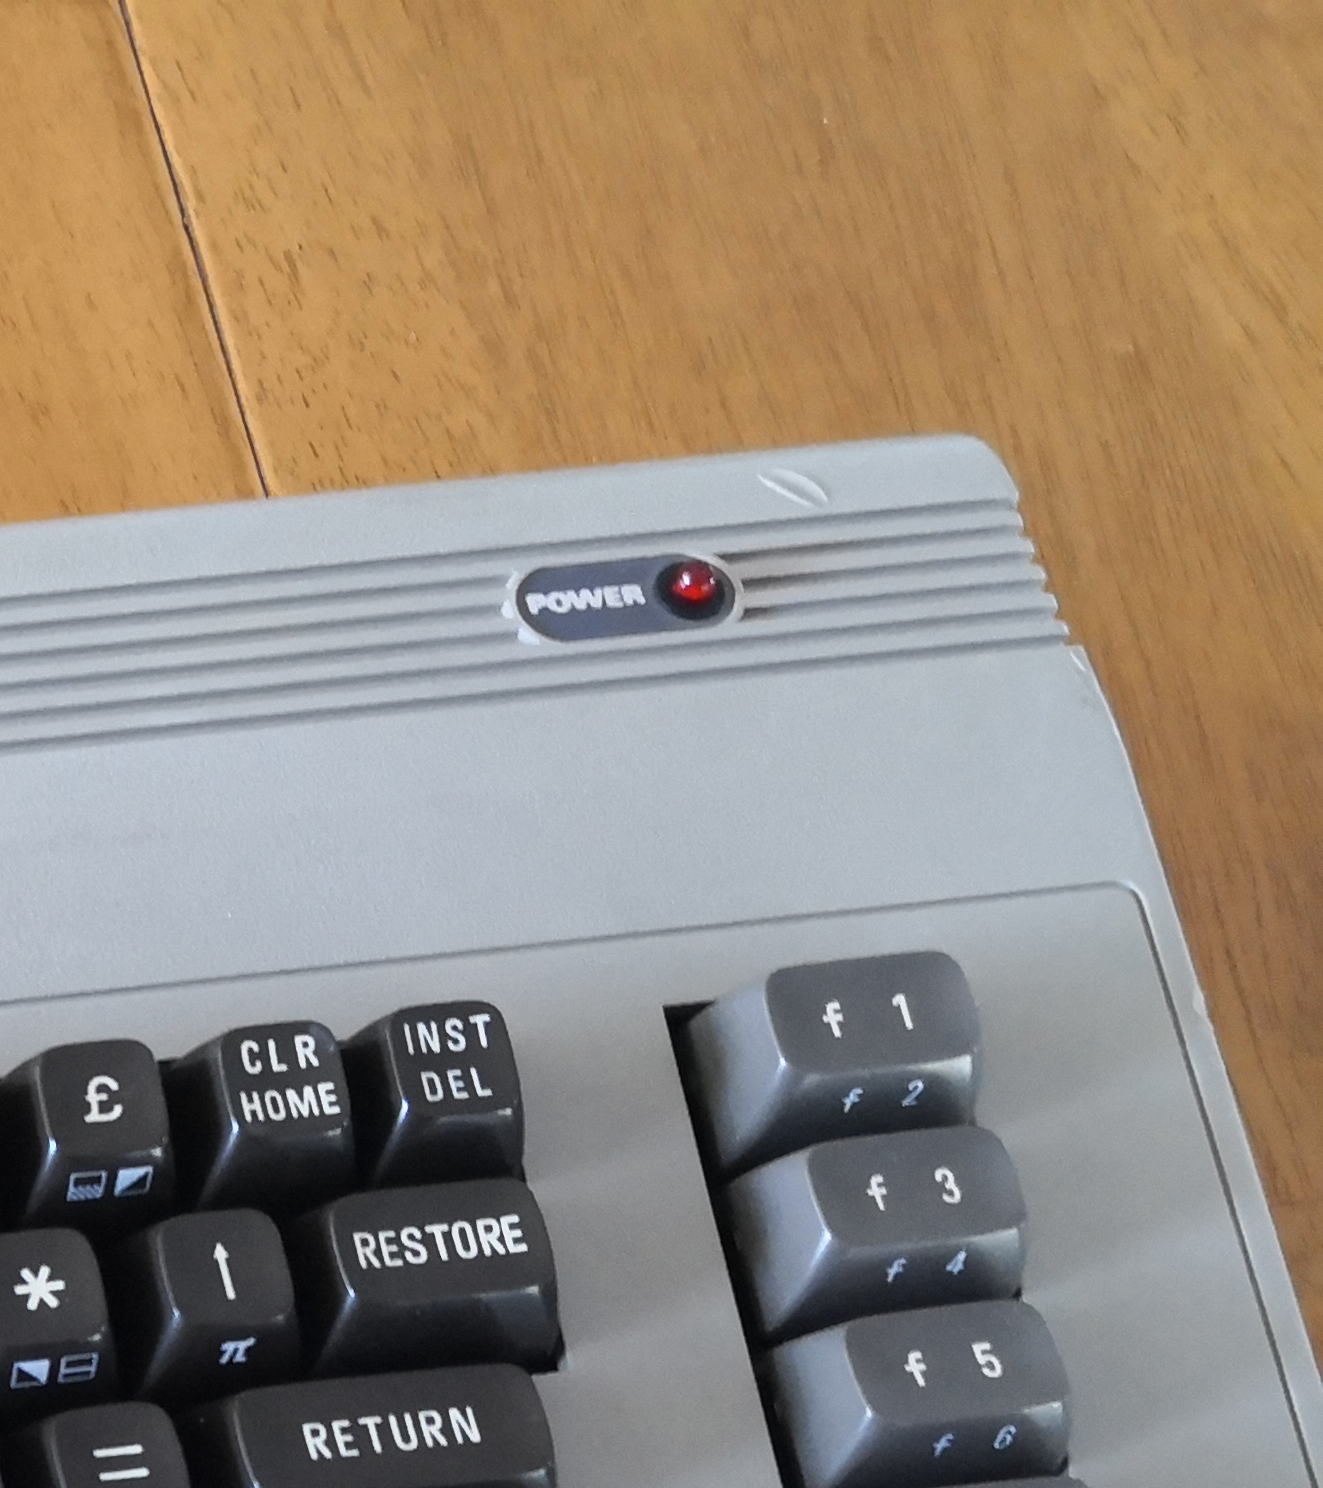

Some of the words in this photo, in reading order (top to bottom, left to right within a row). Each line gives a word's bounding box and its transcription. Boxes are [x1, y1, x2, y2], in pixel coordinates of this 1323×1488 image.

[525, 584, 646, 615] POWER
[240, 1034, 320, 1075] CLR
[403, 1013, 491, 1056] INST
[83, 1075, 123, 1123] £
[239, 1081, 341, 1123] HOME
[420, 1066, 493, 1102] DEL
[352, 1213, 529, 1270] RESTORE
[301, 1405, 482, 1461] RETURN
[92, 1443, 150, 1481] =
